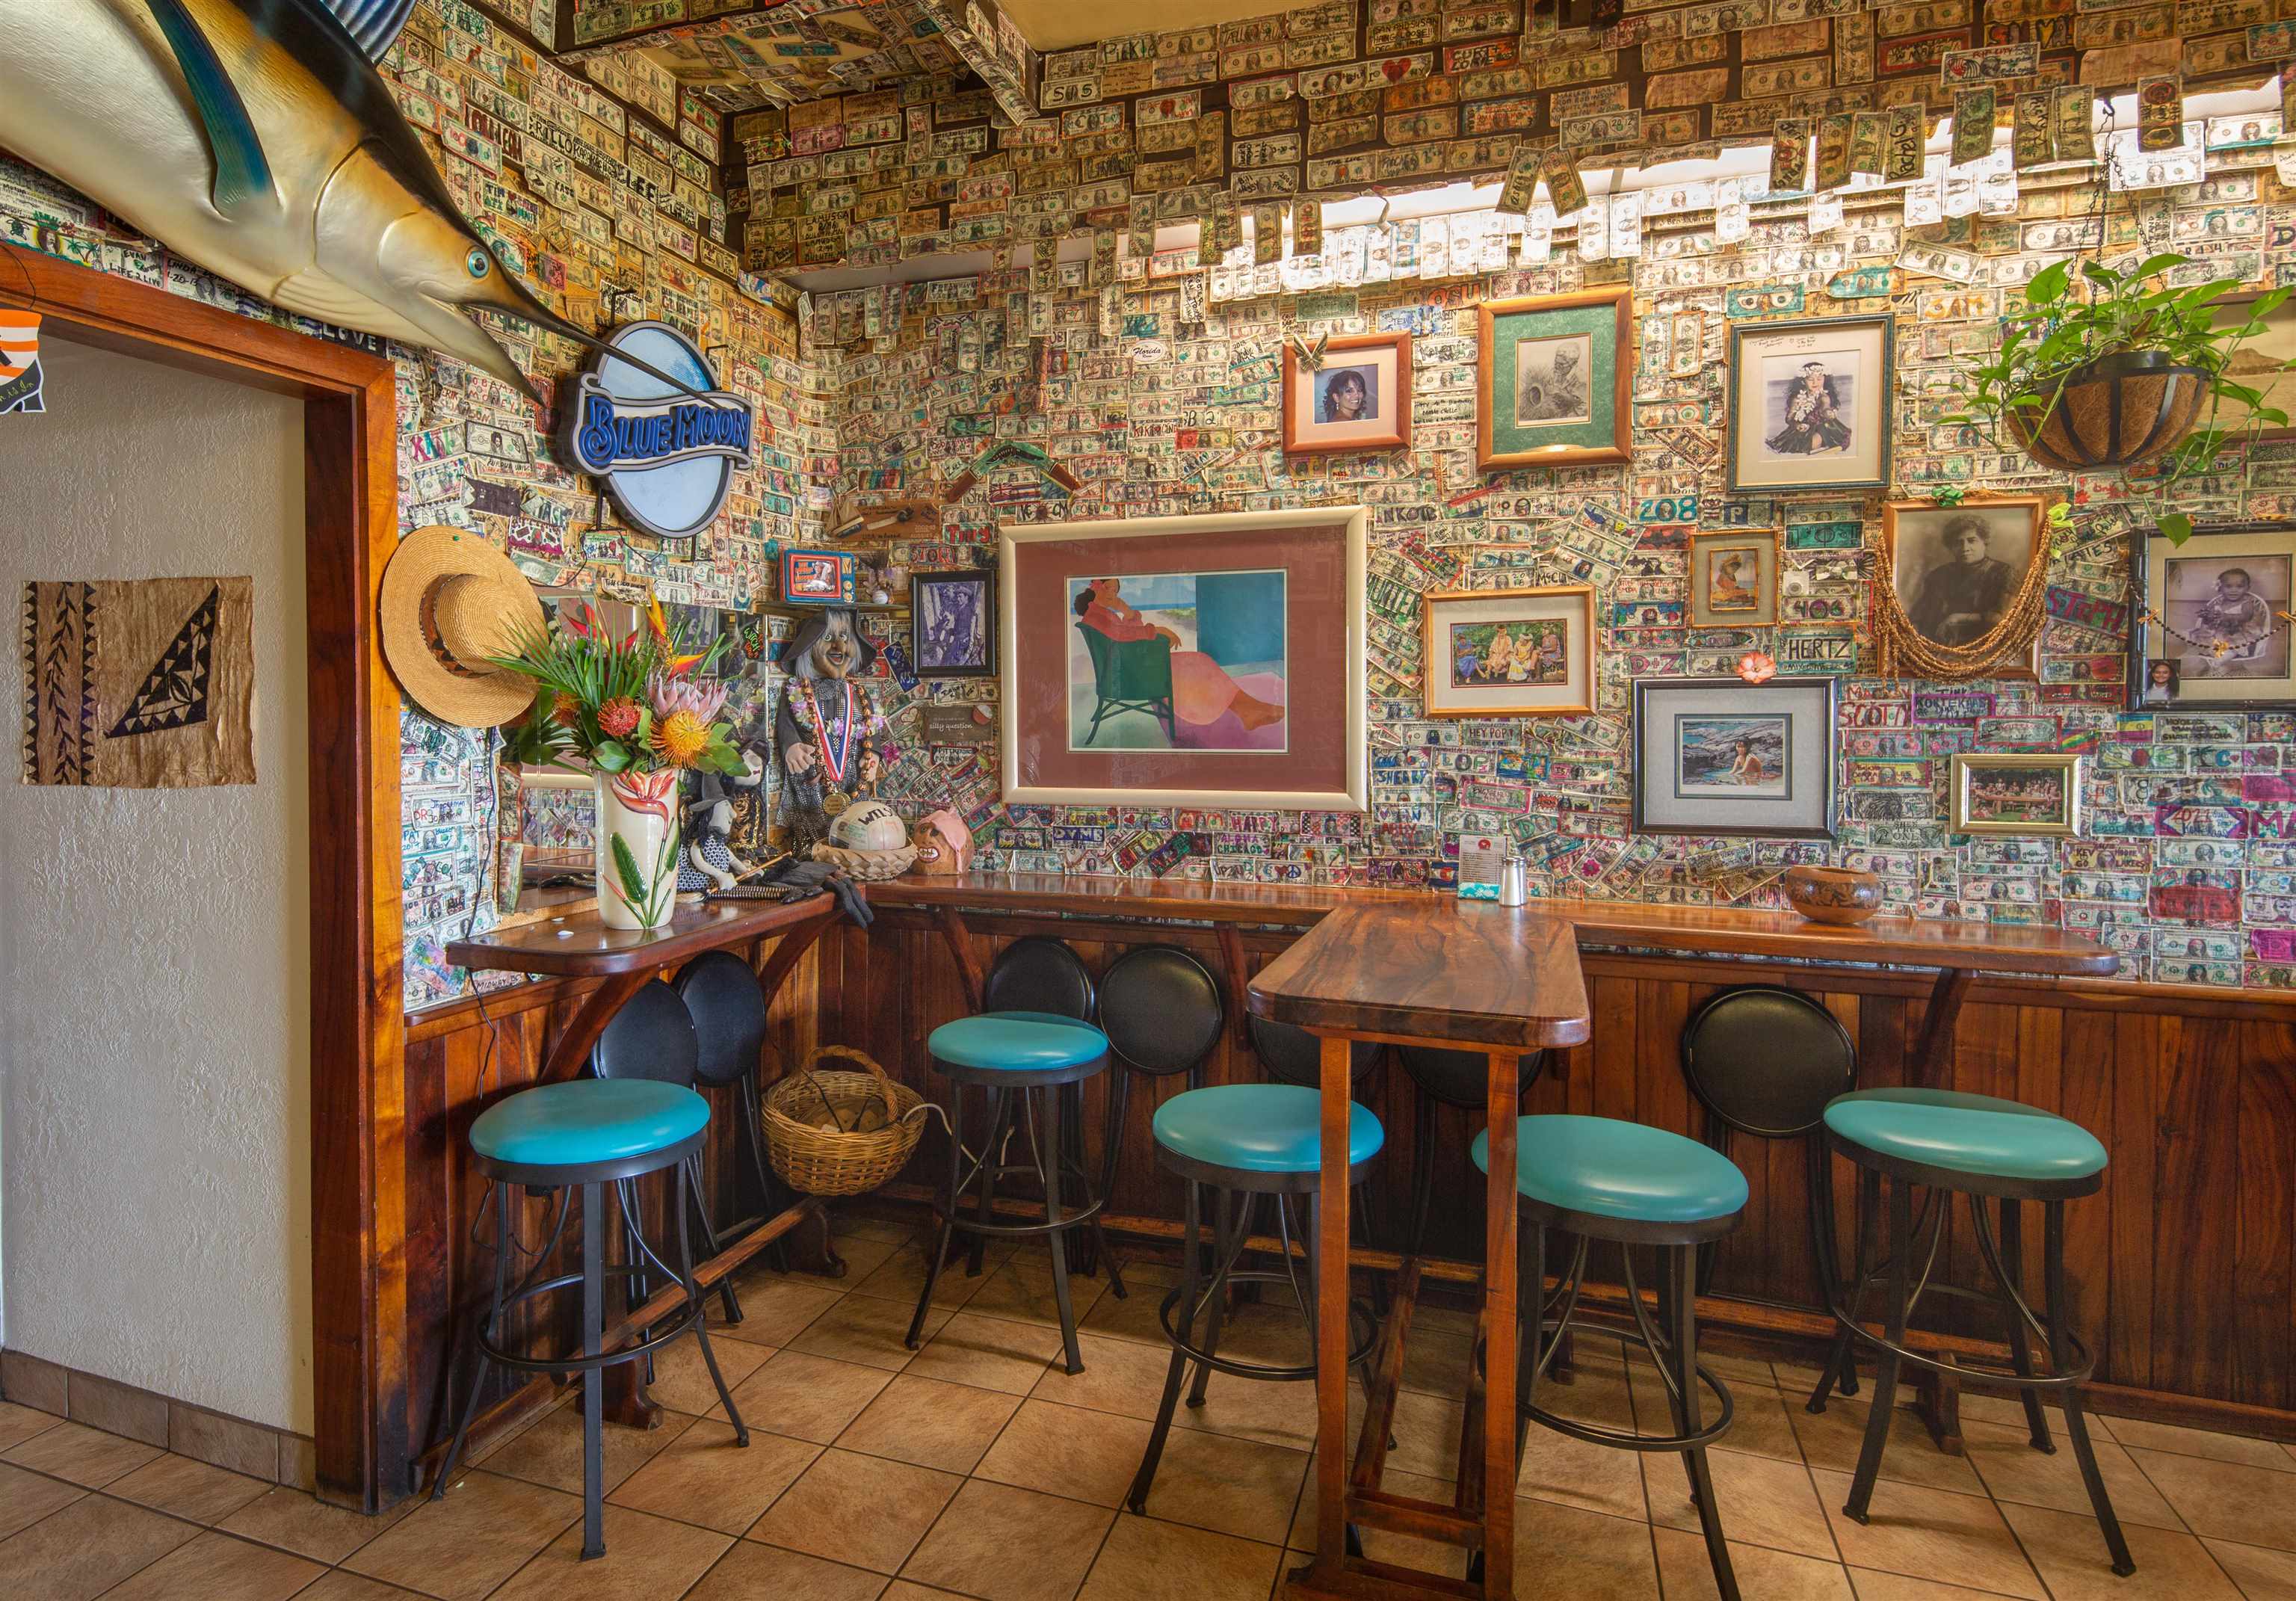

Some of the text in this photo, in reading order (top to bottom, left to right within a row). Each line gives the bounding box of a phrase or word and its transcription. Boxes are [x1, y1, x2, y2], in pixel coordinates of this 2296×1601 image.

[324, 321, 377, 352] LOVE
[1133, 347, 1161, 357] Florida
[472, 377, 515, 395] OBAMA
[469, 388, 516, 413] MONEY
[579, 395, 750, 465] BLUE MOON
[1639, 496, 1697, 522] 208
[1789, 638, 1852, 660] HERTZ
[930, 723, 945, 732] silly
[1469, 728, 1486, 738] HEY
